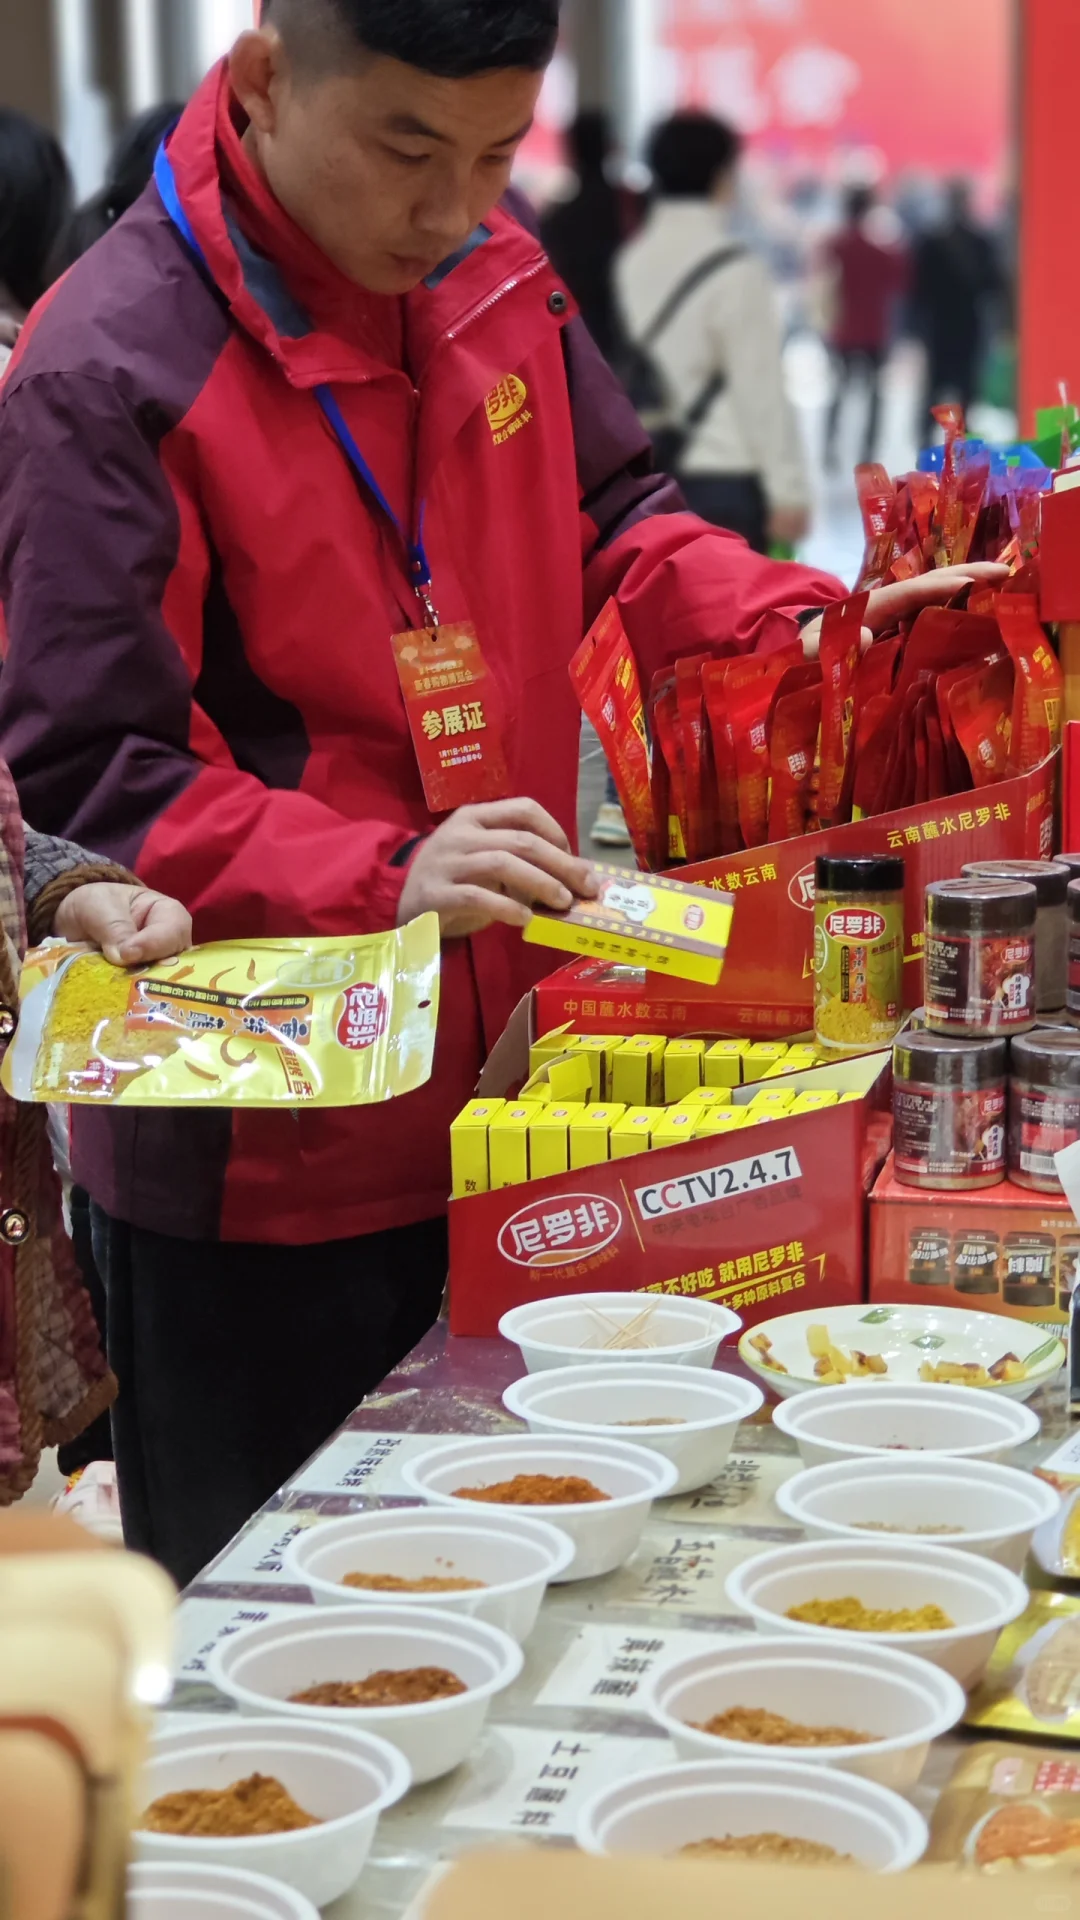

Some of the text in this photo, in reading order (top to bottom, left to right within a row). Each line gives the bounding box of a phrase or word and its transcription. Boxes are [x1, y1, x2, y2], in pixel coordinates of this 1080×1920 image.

[421, 701, 487, 741] 参展证
[886, 803, 1012, 849] 云南蘸水尼罗非
[829, 915, 882, 934] 尼罗非
[346, 987, 379, 1048] 尼罗非
[563, 999, 687, 1022] 中国蘸水数云南
[464, 1180, 478, 1194] 数
[641, 1150, 792, 1215] CCTV2.4.7
[509, 1201, 610, 1256] 尼罗非
[718, 1241, 805, 1284] 就用尼罗非
